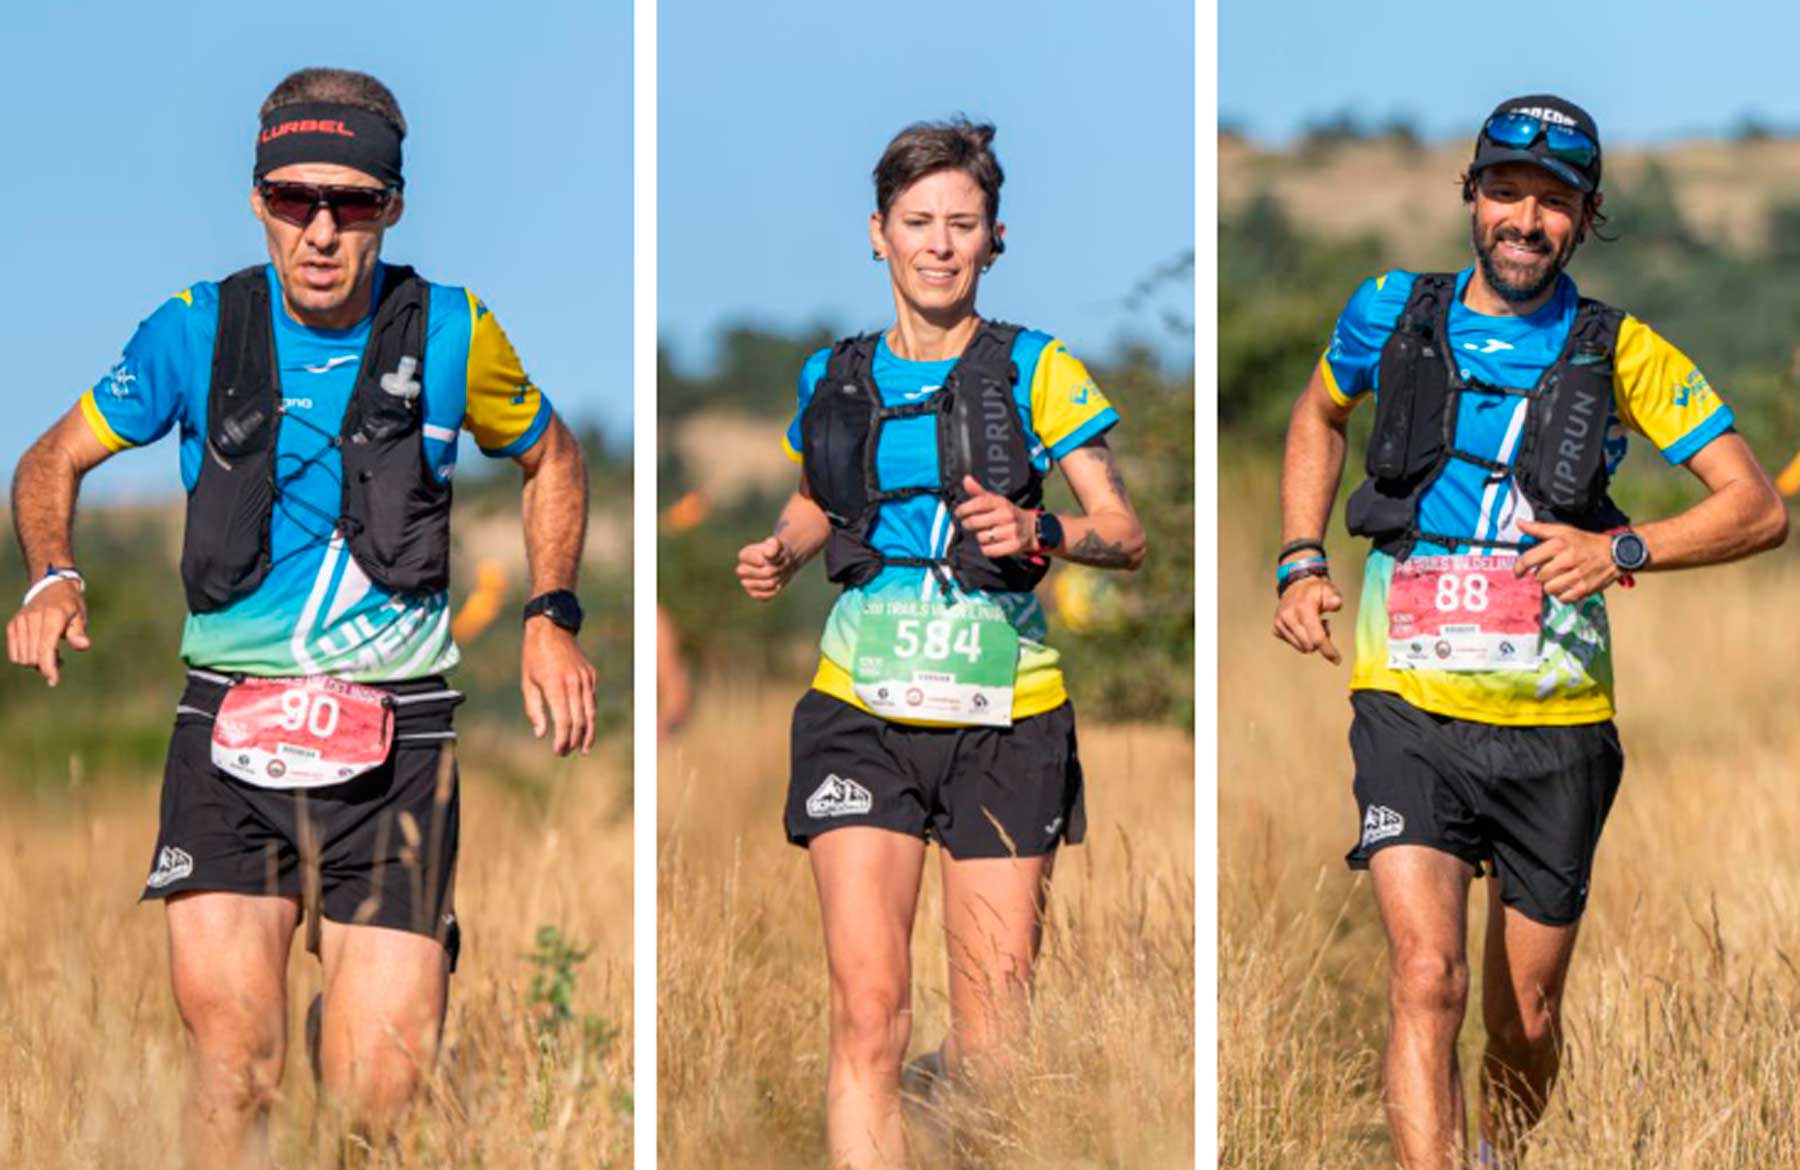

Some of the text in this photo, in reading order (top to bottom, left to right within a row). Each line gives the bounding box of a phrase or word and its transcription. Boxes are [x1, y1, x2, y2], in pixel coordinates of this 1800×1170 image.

[260, 119, 355, 143] LURBEL
[1435, 573, 1489, 612] 88
[893, 619, 982, 663] 584
[281, 689, 340, 737] 90
